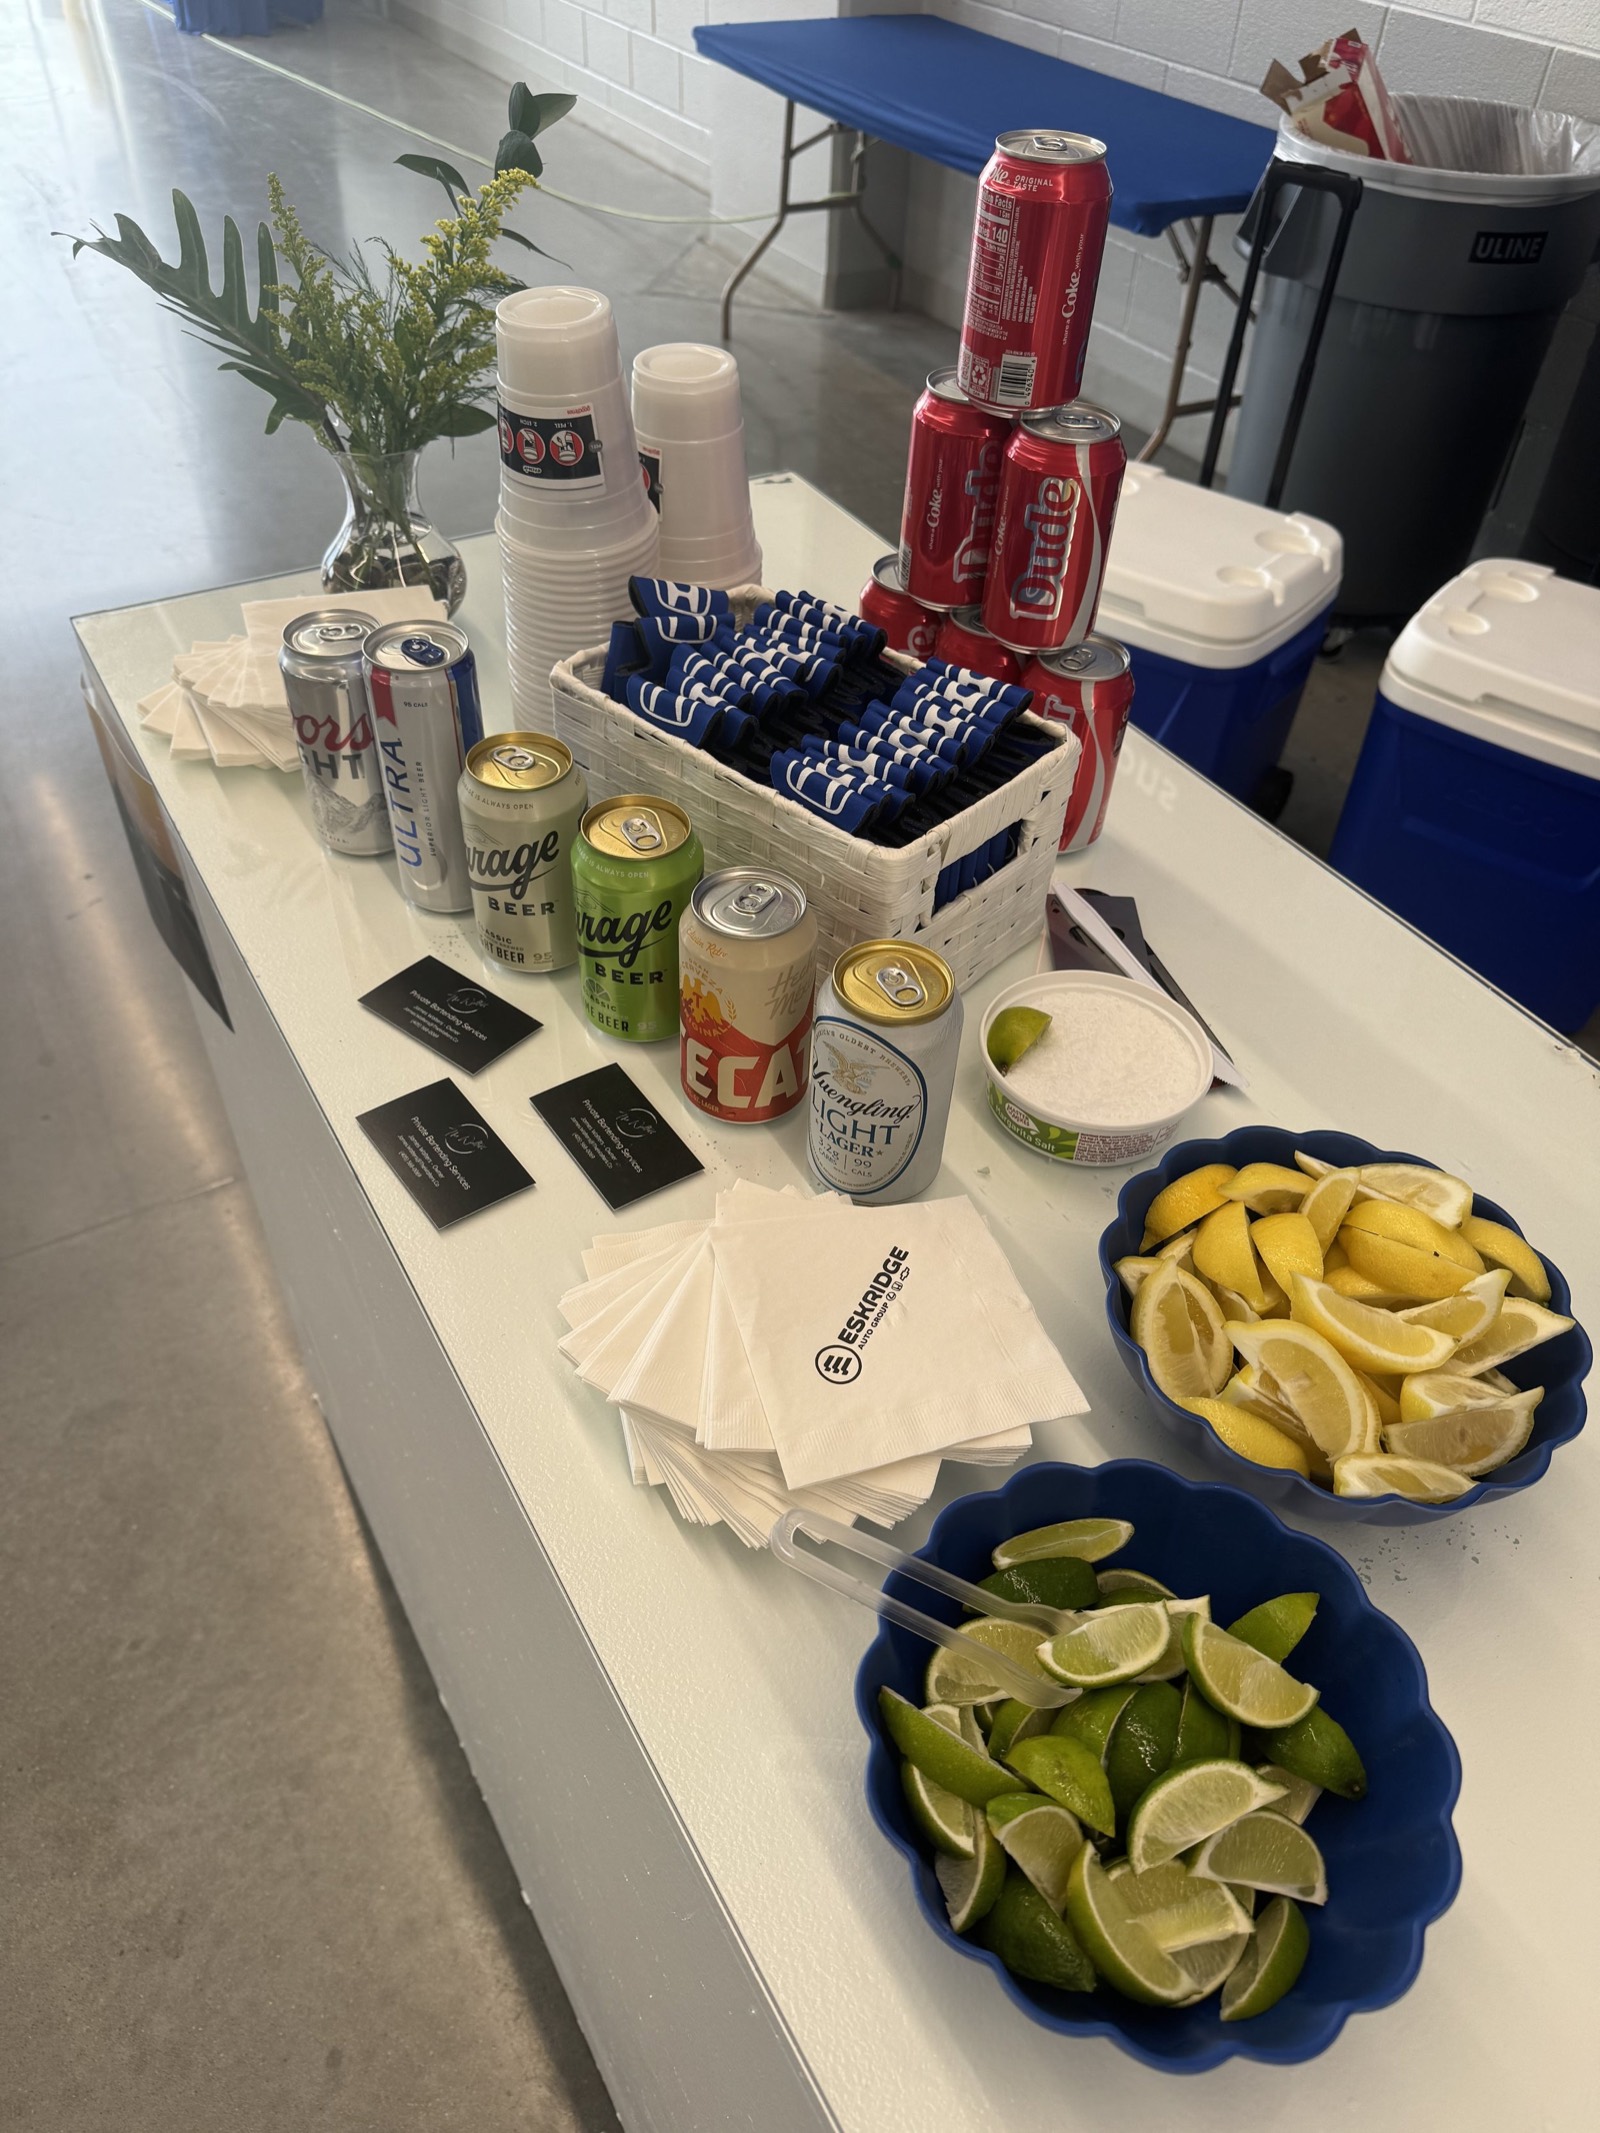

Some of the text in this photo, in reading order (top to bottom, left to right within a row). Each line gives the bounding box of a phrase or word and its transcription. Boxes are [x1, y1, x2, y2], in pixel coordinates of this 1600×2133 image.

[1013, 181, 1038, 192] TASTE
[1015, 174, 1053, 187] ORIGINAL
[992, 226, 1009, 244] 140
[1475, 237, 1542, 259] ULINE
[1062, 271, 1081, 318] Coke
[1062, 323, 1070, 345] share
[926, 489, 942, 528] Coke
[995, 516, 1007, 555] Coke
[1010, 477, 1082, 620] Dude
[380, 738, 422, 867] ULTRA
[416, 761, 437, 857] SUPERIOR LIGHT BEER
[482, 798, 510, 810] ALWAYS
[595, 865, 625, 878] ALWAYS
[488, 896, 556, 916] BEER
[496, 947, 525, 964] BEER
[533, 952, 552, 961] 95
[705, 941, 728, 958] Retro
[595, 961, 664, 985] BEER
[409, 990, 432, 1004] Private
[428, 1003, 463, 1025] Bartending
[461, 1023, 489, 1040] Services
[598, 1012, 629, 1032] BEER
[637, 1021, 657, 1031] 95
[839, 1033, 876, 1054] OLDEST
[701, 1100, 719, 1113] LAGER
[581, 1099, 601, 1118] Private
[595, 1118, 625, 1149] Bartending
[620, 1148, 644, 1172] Services
[994, 1104, 1033, 1142] Margarita
[1034, 1138, 1056, 1153] Salt
[818, 1136, 839, 1161] 3.2g
[820, 1122, 875, 1158] LAGER
[410, 1116, 430, 1136] Private
[423, 1135, 453, 1166] Bartending
[448, 1165, 472, 1190] Services
[854, 1158, 872, 1168] 99
[851, 1168, 872, 1178] CALS
[837, 1245, 910, 1345] ESKRIDGE
[857, 1302, 889, 1350] AUTO GROUP
